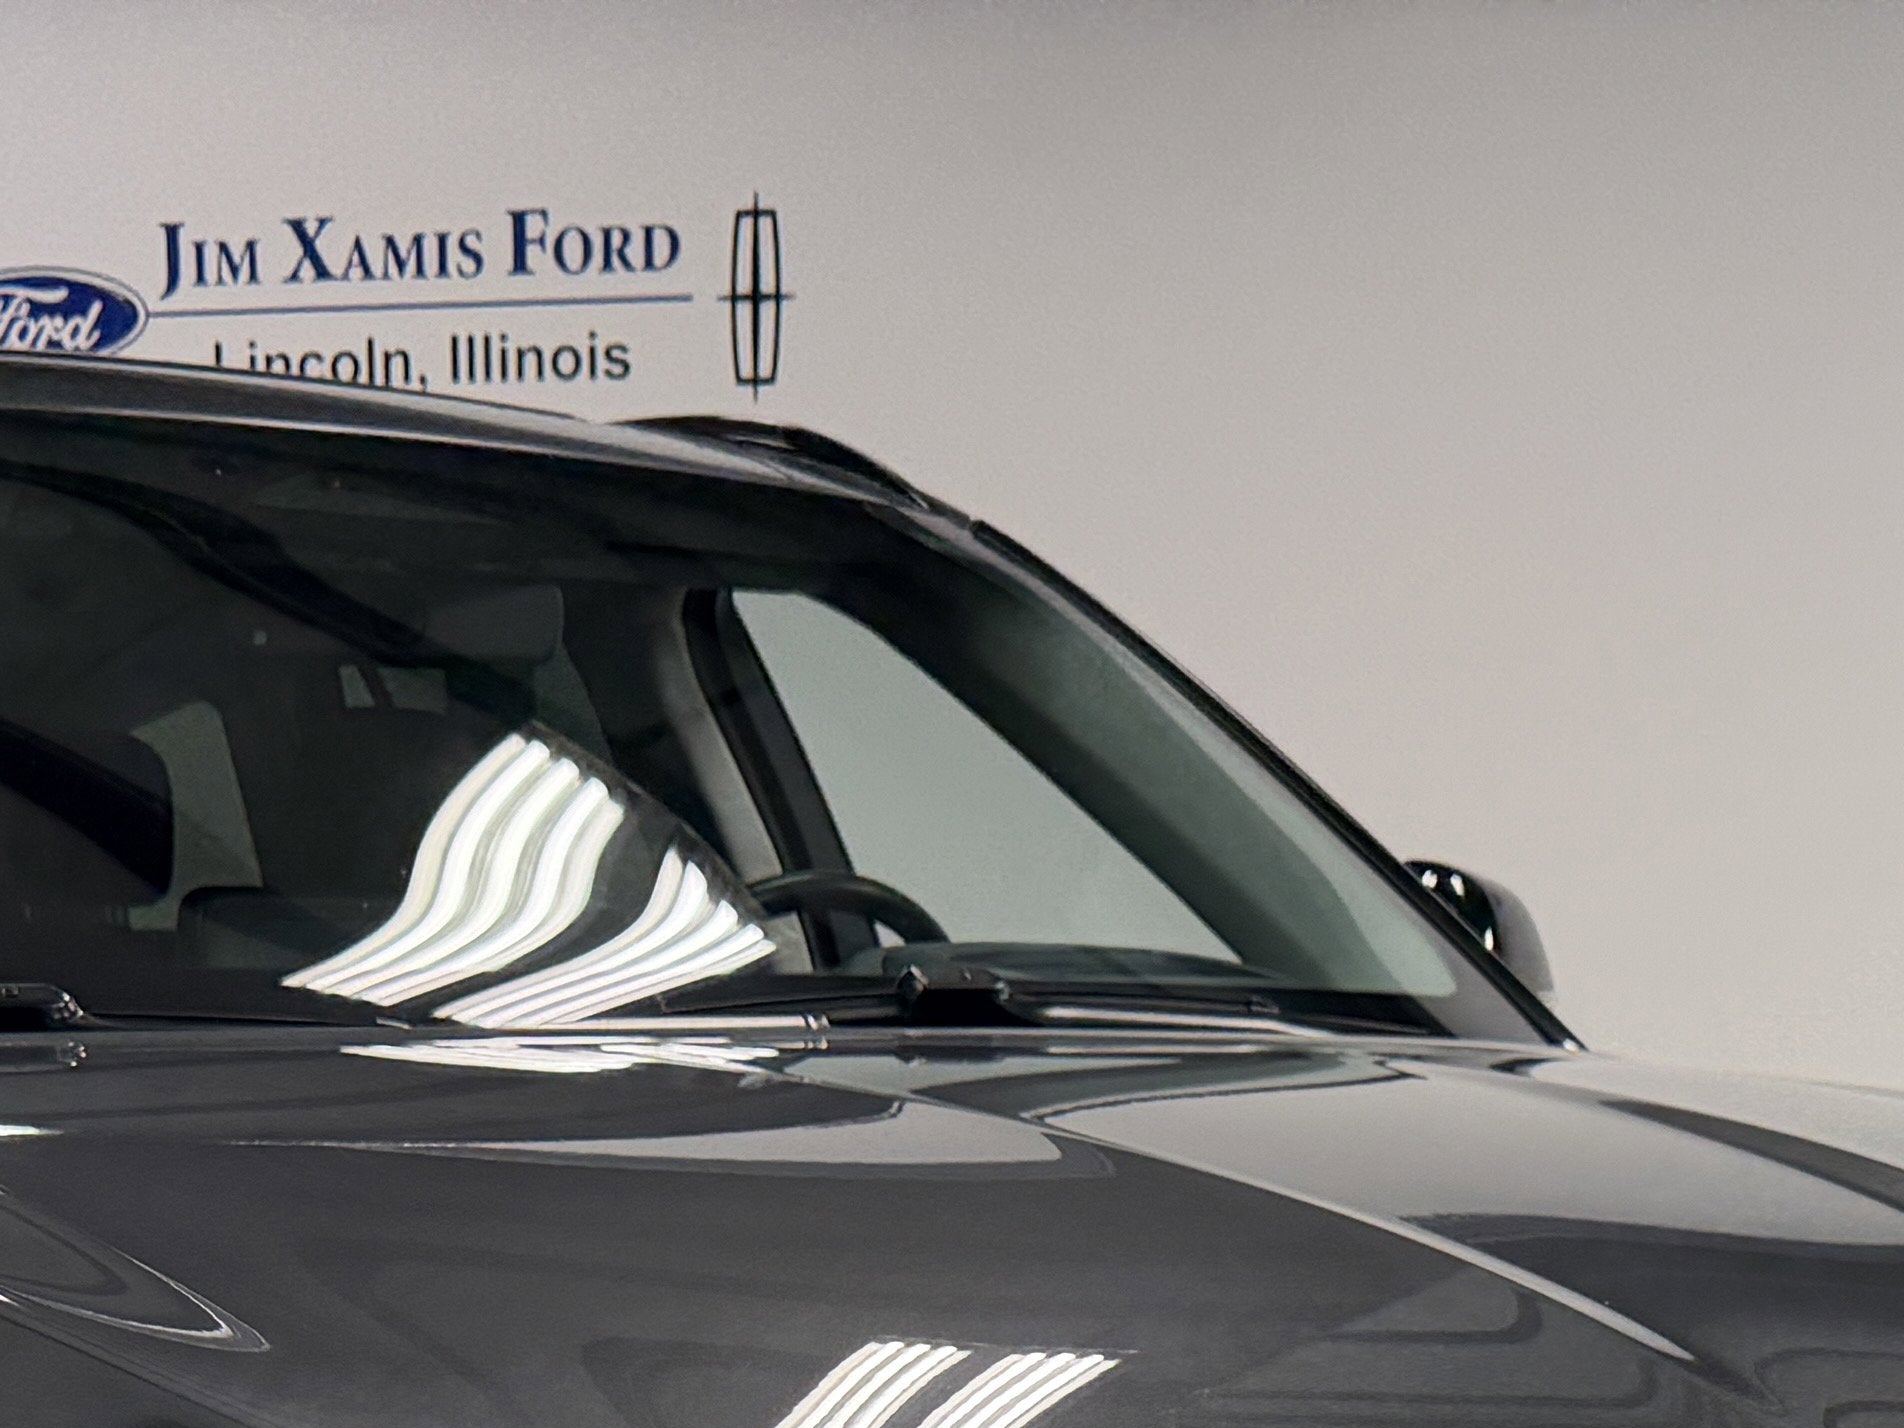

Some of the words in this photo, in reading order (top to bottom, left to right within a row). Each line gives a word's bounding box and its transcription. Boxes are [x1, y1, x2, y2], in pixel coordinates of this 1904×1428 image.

[159, 223, 260, 301] JIM
[284, 217, 485, 284] XAMIS
[506, 208, 682, 276] FORD
[450, 330, 633, 384] Illinois
